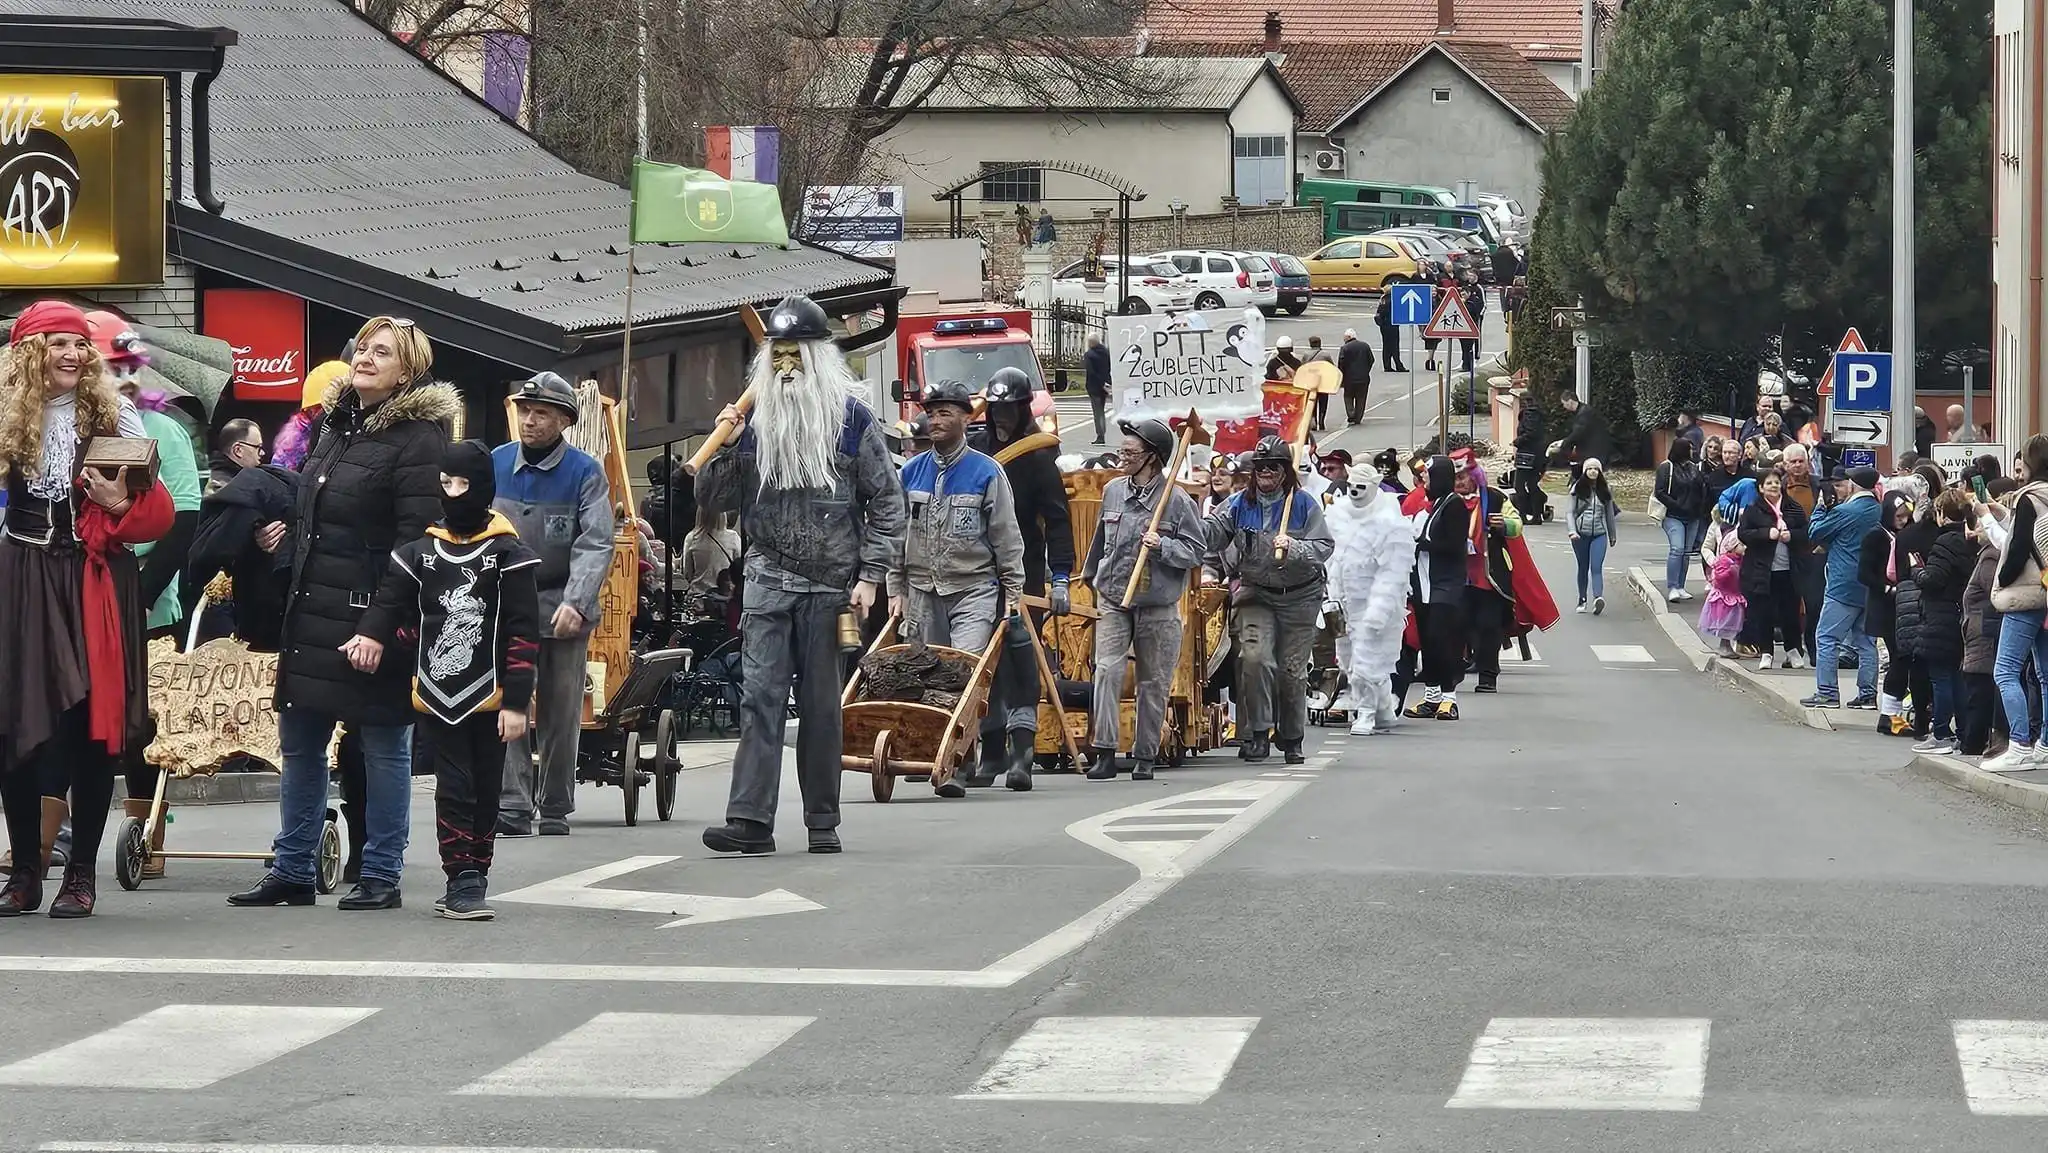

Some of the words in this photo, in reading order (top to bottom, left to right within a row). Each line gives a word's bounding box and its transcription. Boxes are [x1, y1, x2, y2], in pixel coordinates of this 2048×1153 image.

[61, 92, 125, 132] bar
[3, 170, 72, 248] ART
[976, 352, 984, 360] 2
[1153, 329, 1213, 358] PTT
[1128, 355, 1228, 378] ZGUBLENI
[1143, 376, 1245, 399] PINGVINI
[1849, 364, 1878, 401] P
